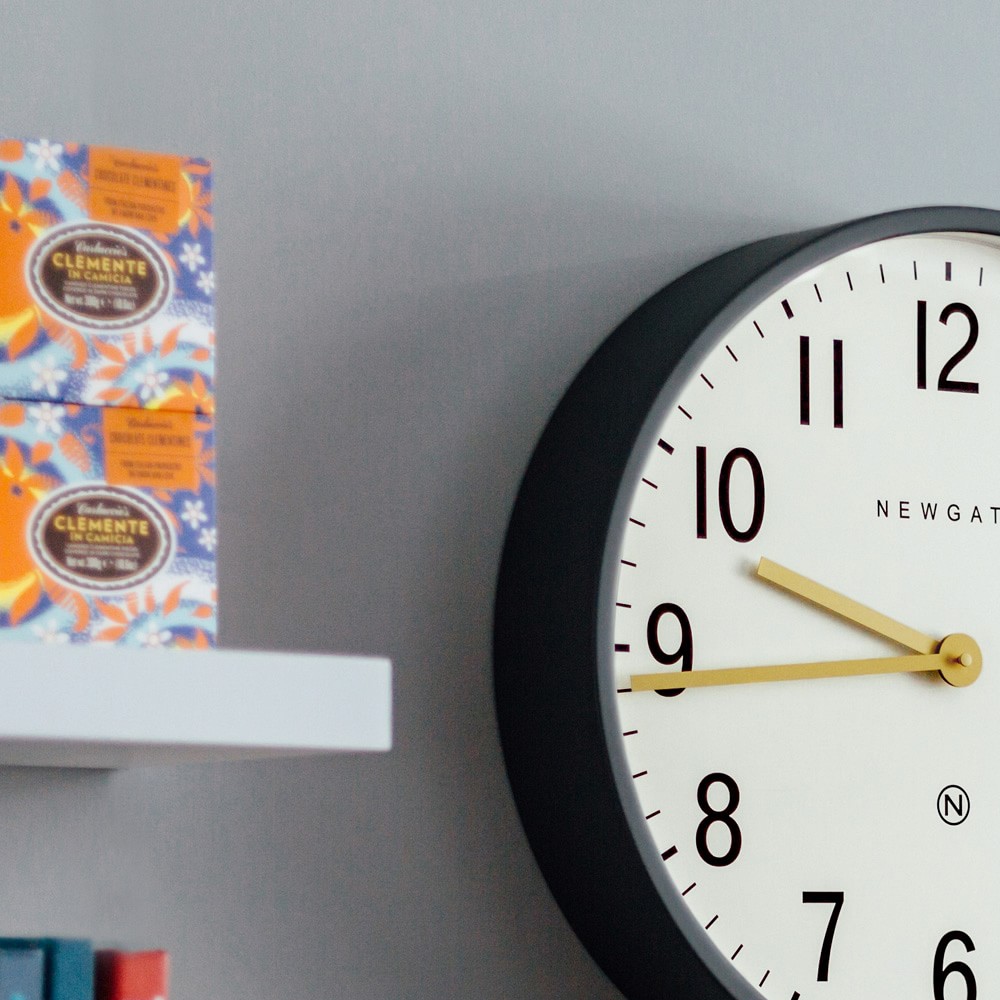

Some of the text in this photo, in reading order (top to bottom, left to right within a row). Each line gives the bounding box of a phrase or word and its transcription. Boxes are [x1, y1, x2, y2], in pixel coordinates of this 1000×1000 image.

[52, 252, 147, 277] CLEMENTE
[68, 269, 132, 285] IN CAMICIA
[800, 336, 843, 428] 11
[916, 300, 980, 394] 12
[53, 514, 149, 536] CLEMENTE
[85, 532, 135, 545] CAMICIA
[696, 446, 766, 543] 10
[646, 602, 694, 697] 9
[695, 772, 742, 868] 8
[803, 891, 845, 982] 7
